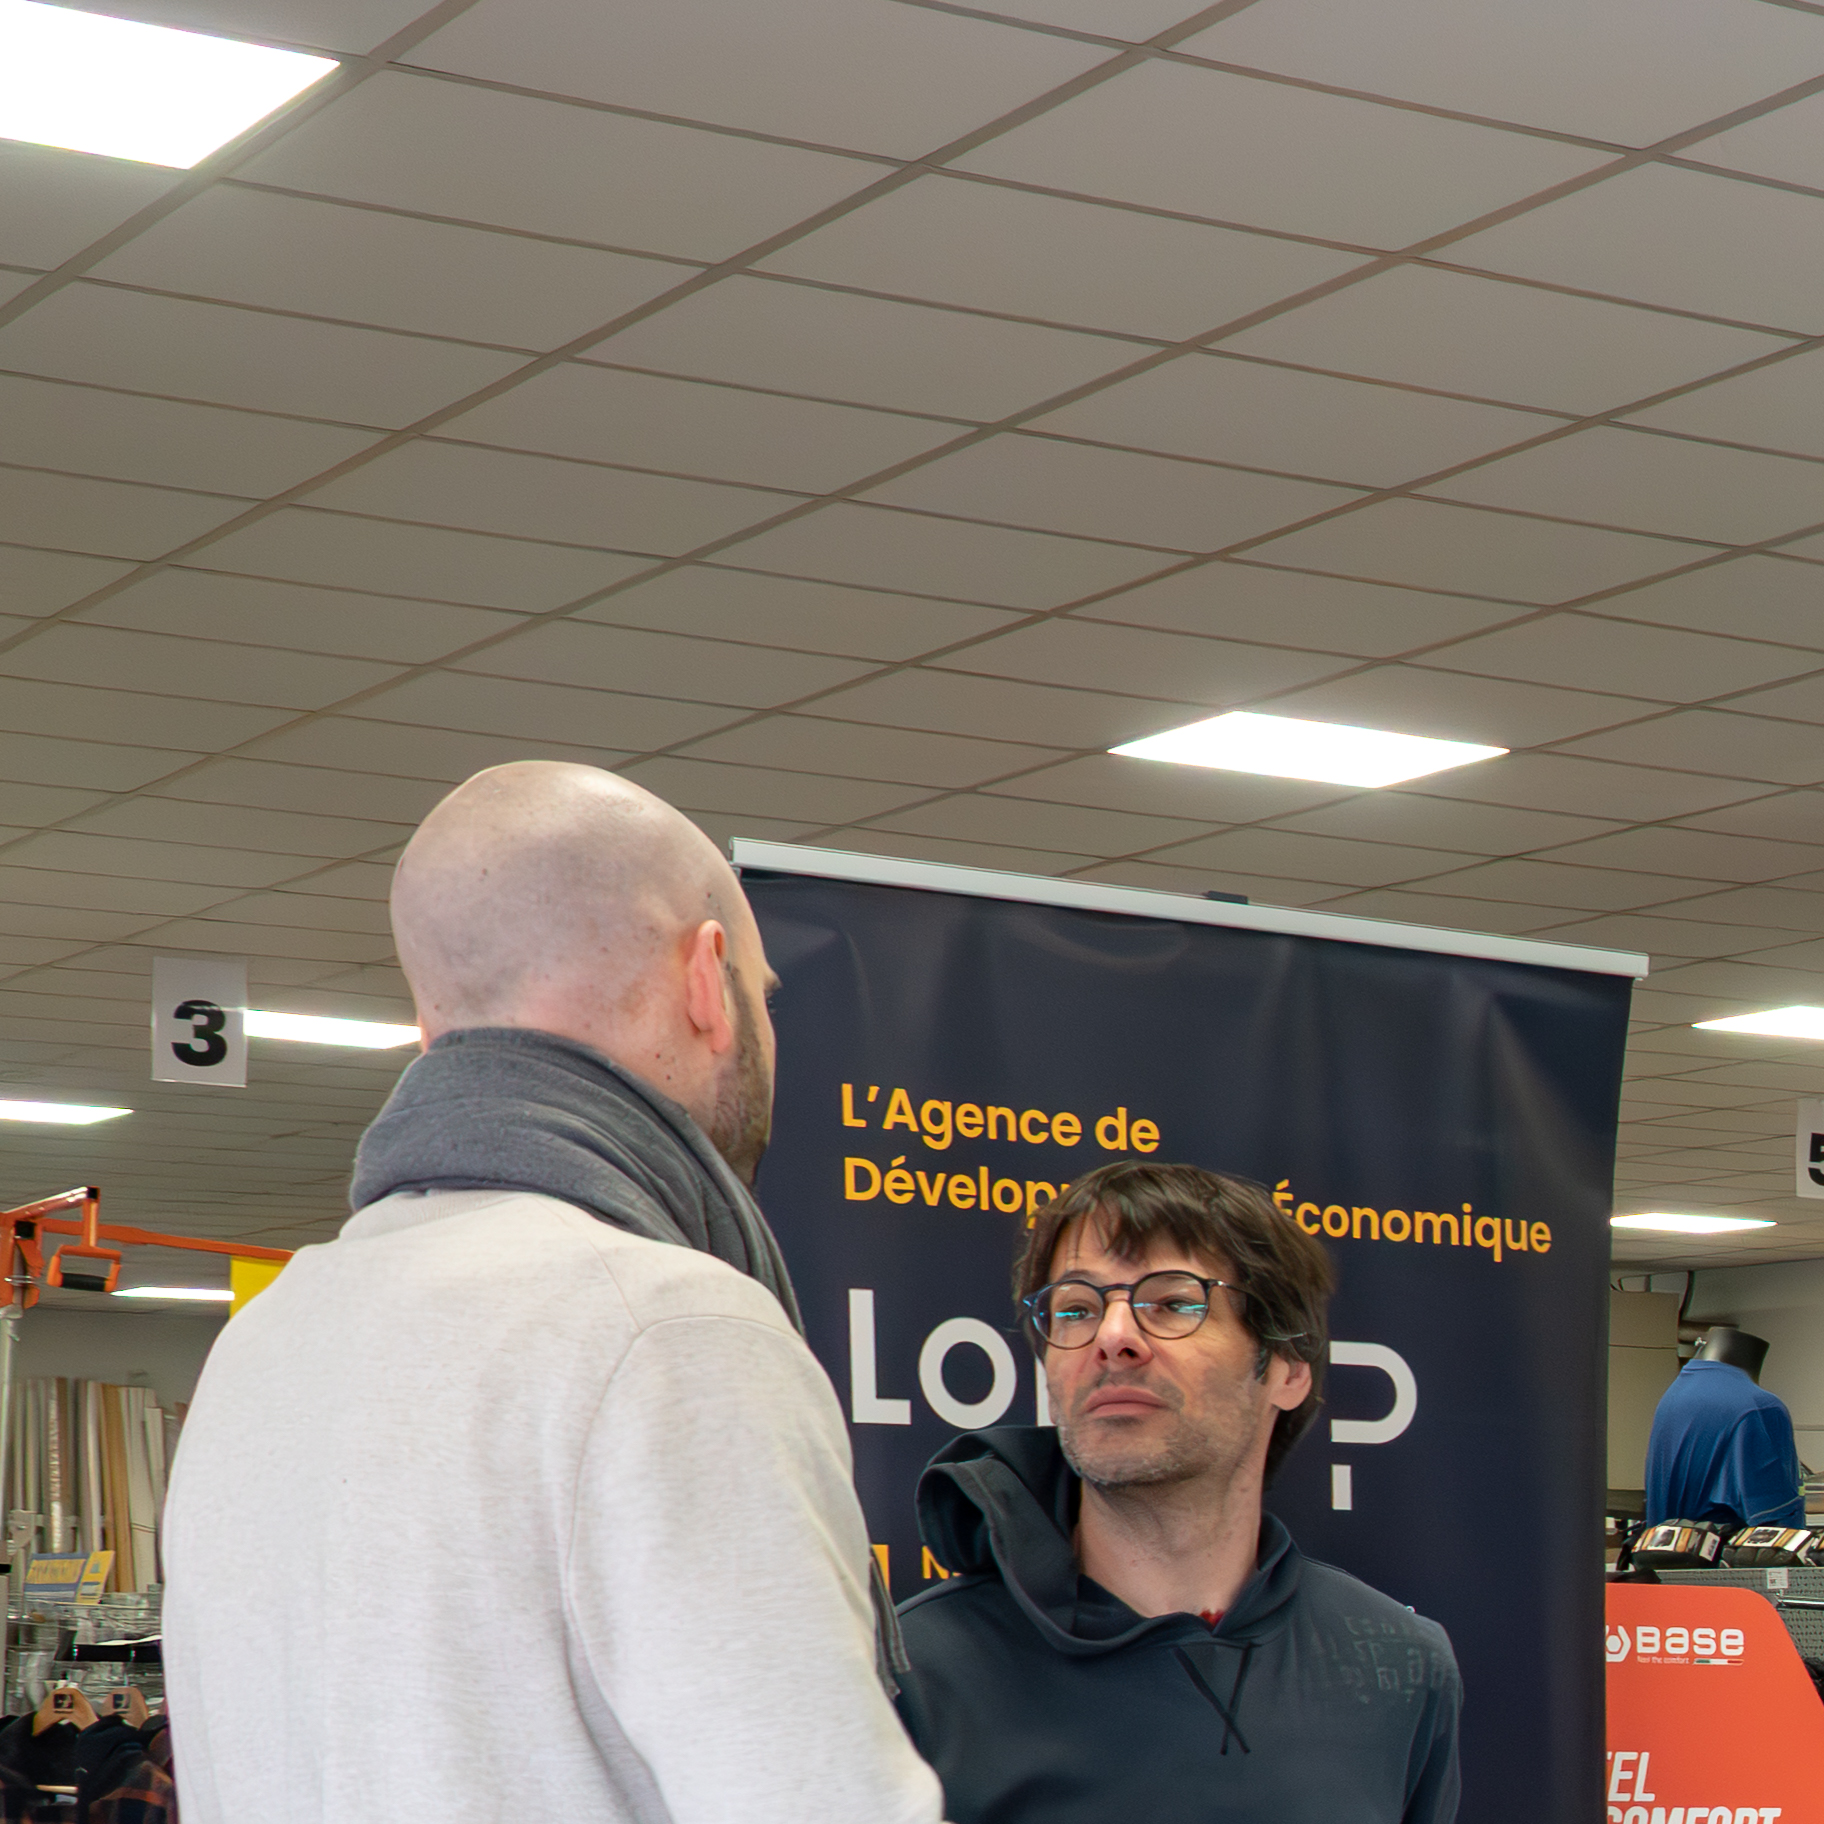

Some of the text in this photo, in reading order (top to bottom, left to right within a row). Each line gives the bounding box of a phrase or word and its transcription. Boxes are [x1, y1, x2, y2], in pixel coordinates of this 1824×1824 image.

[172, 999, 228, 1068] 3
[1095, 1106, 1161, 1153] de
[1607, 1751, 1655, 1802] EL
